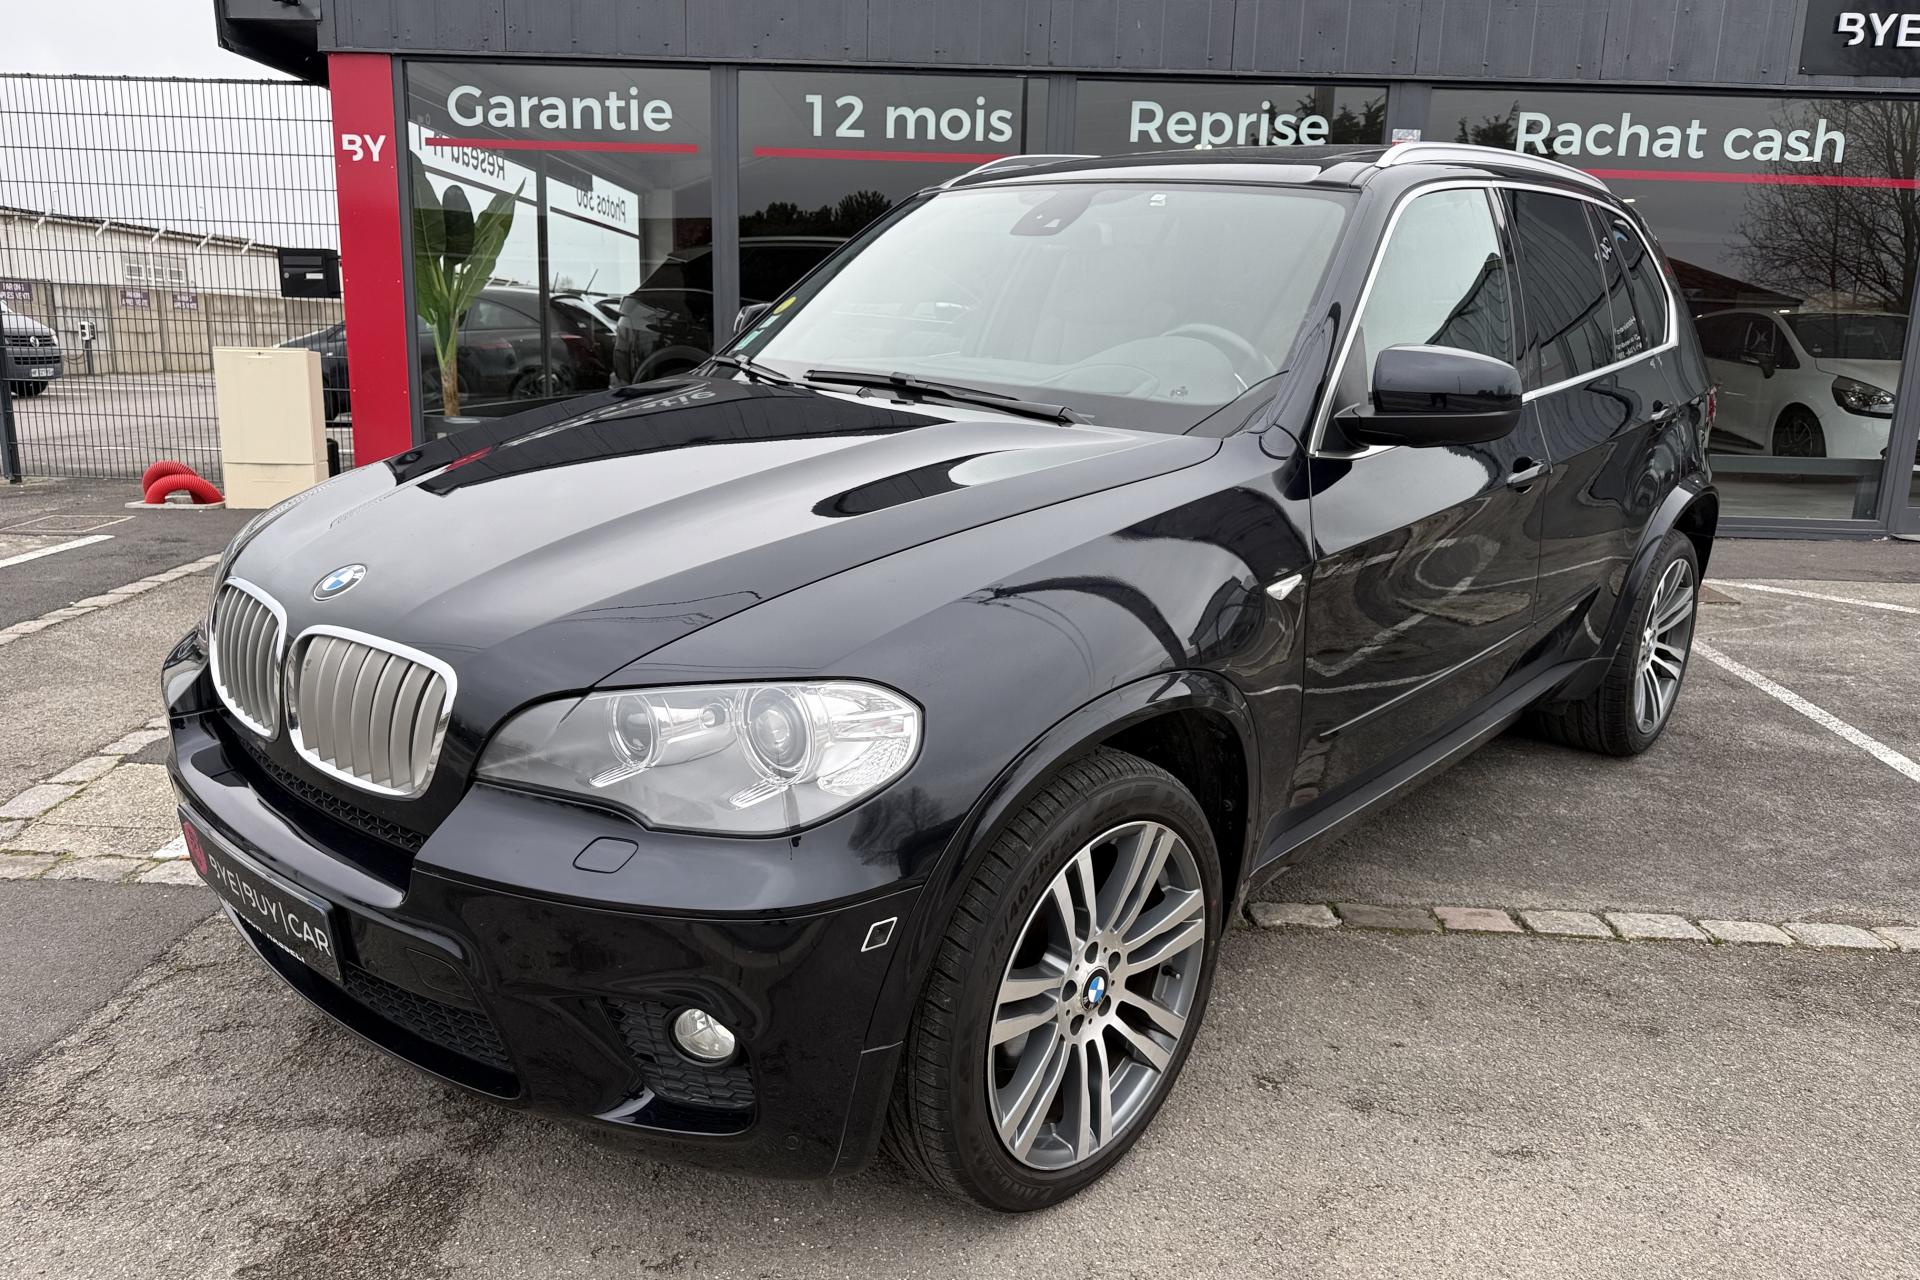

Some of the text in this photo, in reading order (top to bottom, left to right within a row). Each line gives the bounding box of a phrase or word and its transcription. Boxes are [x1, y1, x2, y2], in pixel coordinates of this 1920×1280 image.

[1837, 11, 1920, 47] BYE
[446, 85, 674, 132] Garantie
[805, 93, 1014, 143] 12 mois
[1129, 99, 1330, 148] Reprise
[341, 133, 387, 163] BY
[1514, 111, 1846, 164] Rachat cash
